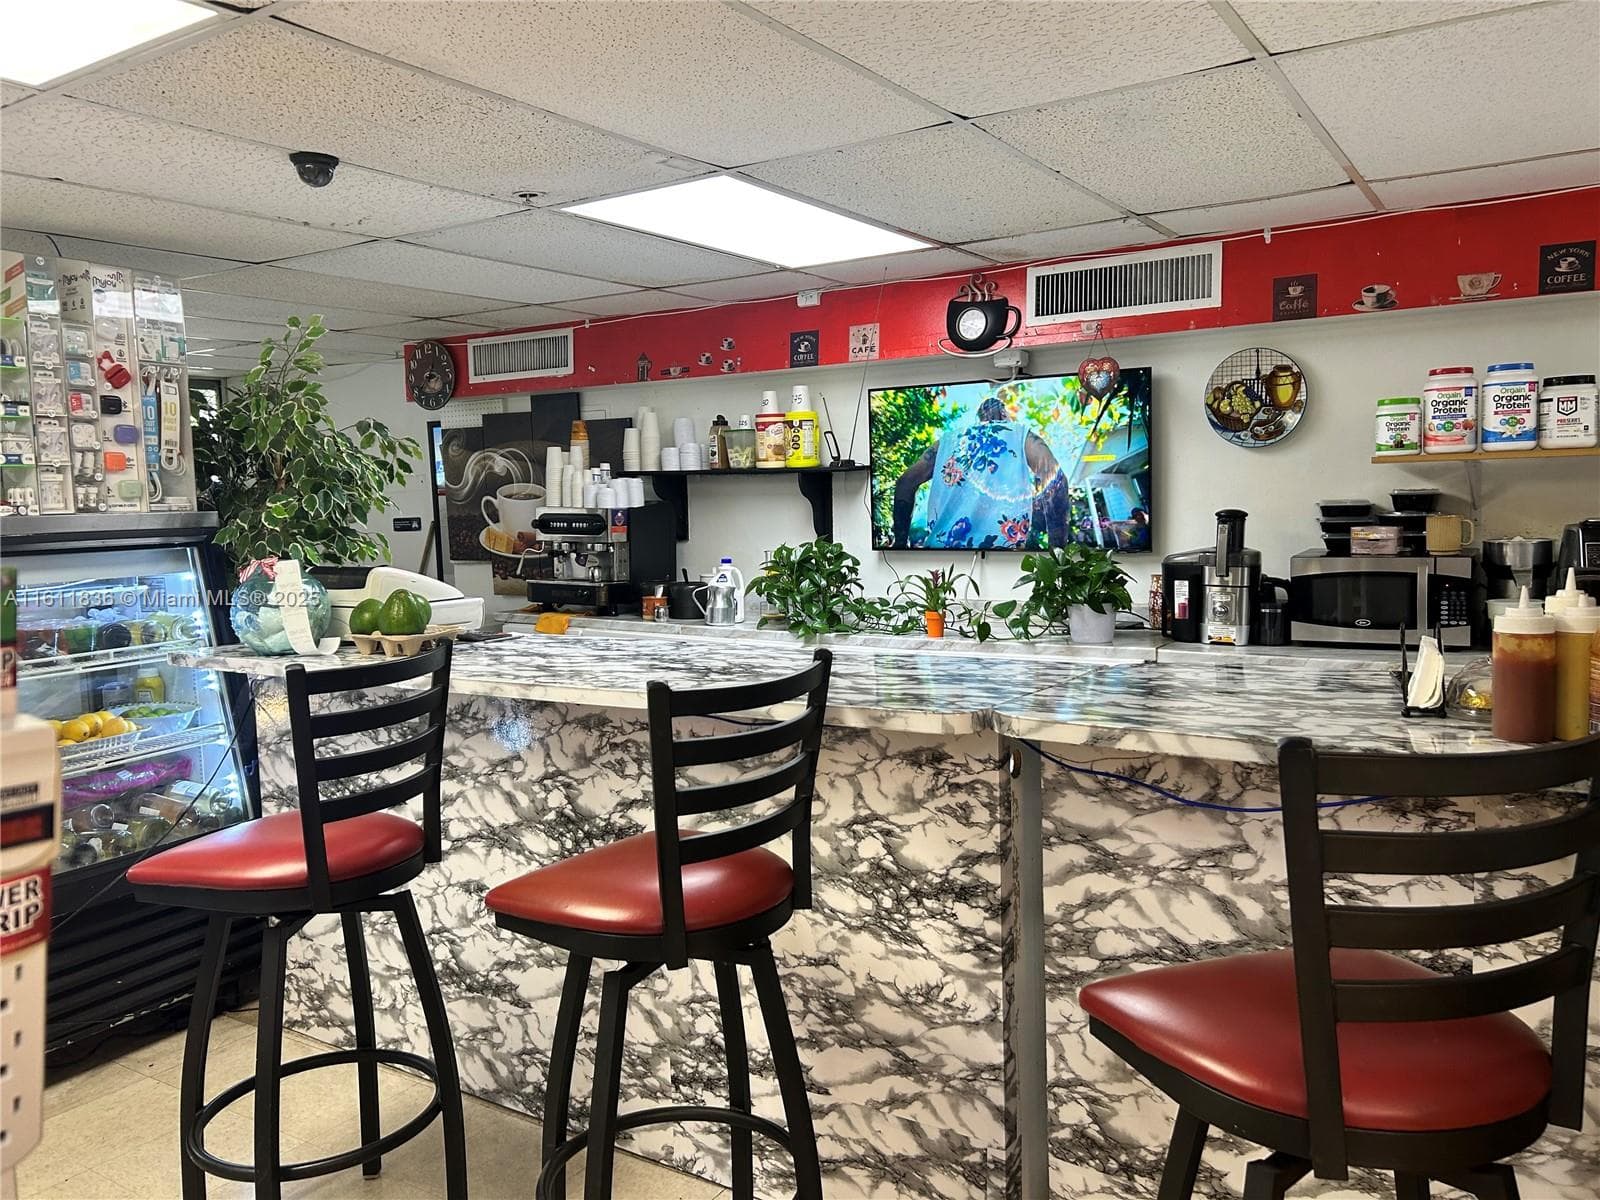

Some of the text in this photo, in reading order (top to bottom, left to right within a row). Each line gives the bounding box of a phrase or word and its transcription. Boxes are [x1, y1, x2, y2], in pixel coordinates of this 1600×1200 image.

[1547, 248, 1567, 260] NEW
[1546, 272, 1587, 284] COFFEE
[851, 342, 877, 354] CAFÉ
[1430, 399, 1468, 409] Organic
[1492, 393, 1532, 404] Organic
[1433, 406, 1466, 414] Protein
[1495, 401, 1530, 410] Protein
